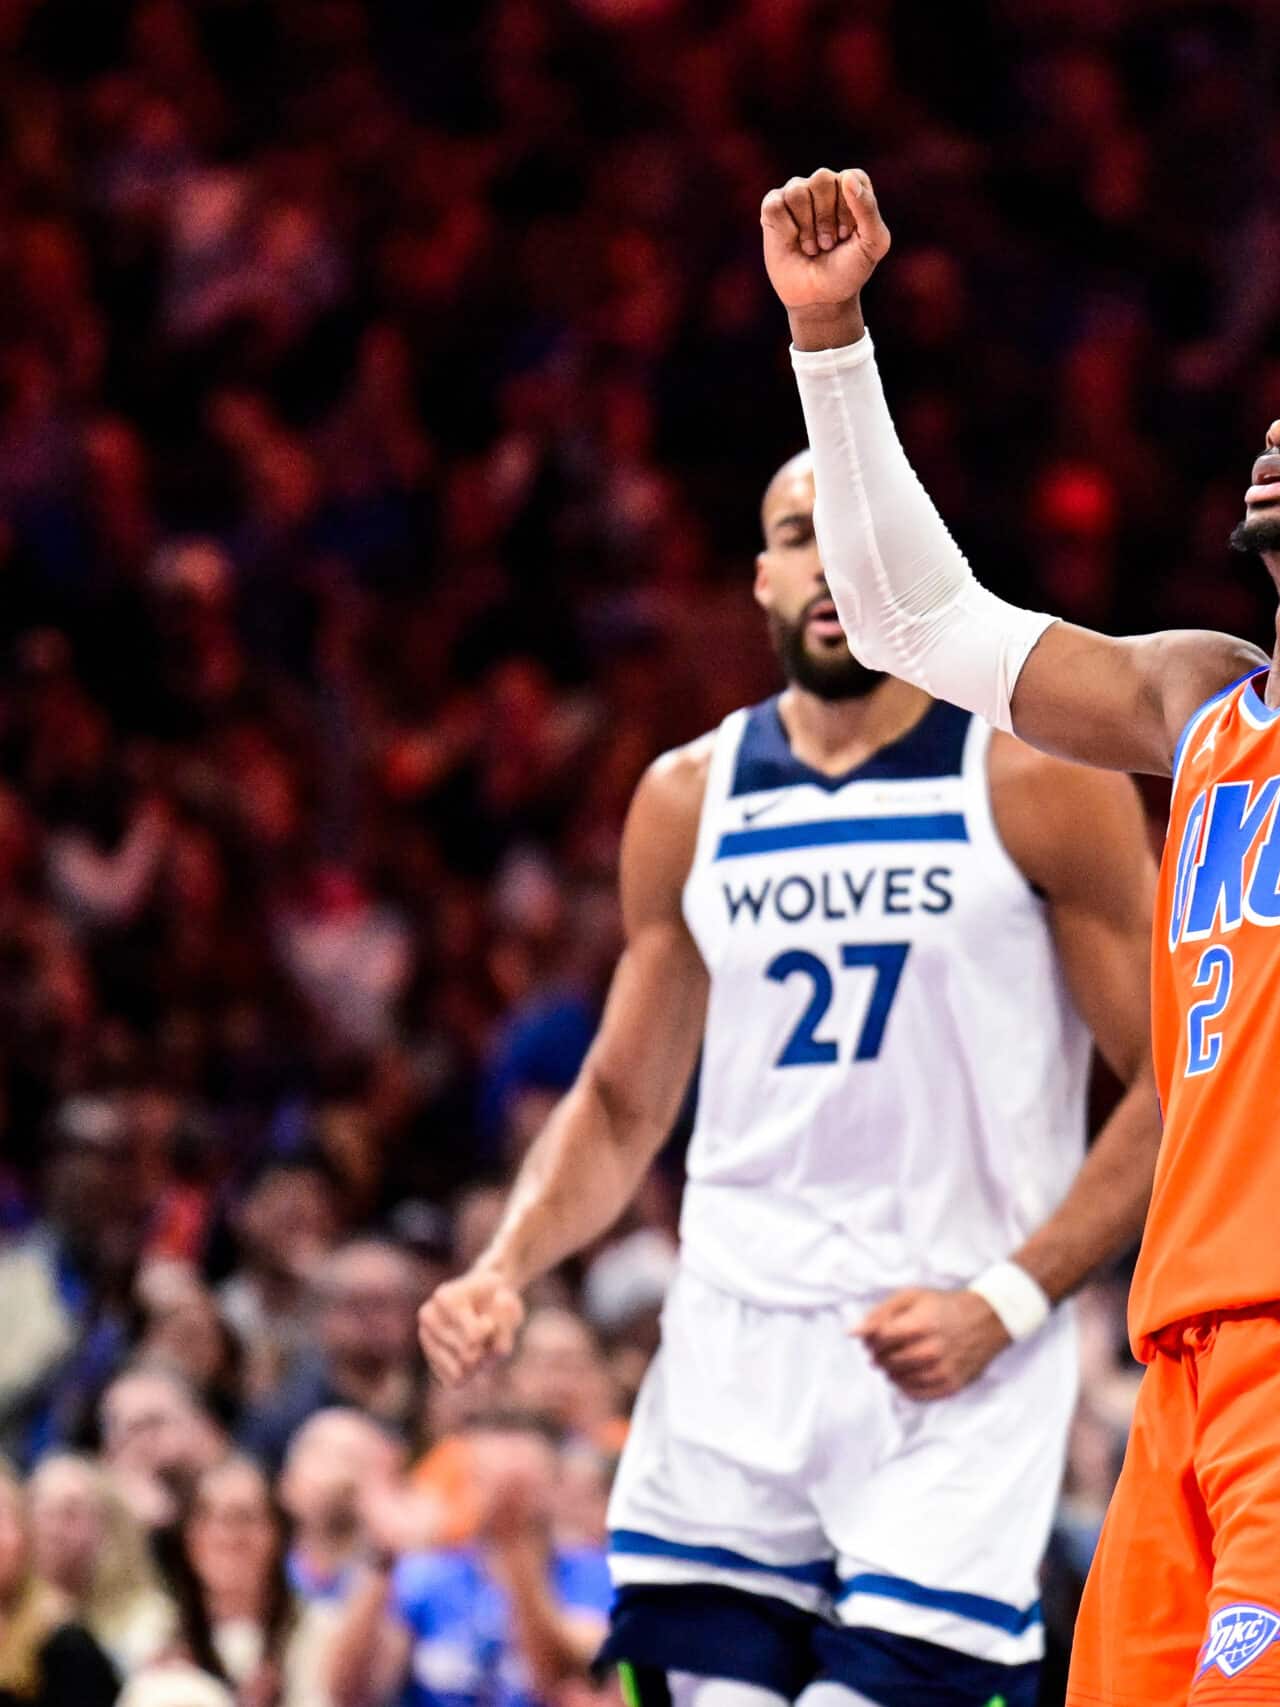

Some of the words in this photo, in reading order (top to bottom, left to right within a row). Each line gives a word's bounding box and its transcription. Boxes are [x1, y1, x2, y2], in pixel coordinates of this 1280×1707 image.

[722, 866, 954, 926] WOLVES
[763, 942, 911, 1069] 27
[1183, 943, 1233, 1078] 2
[1203, 1619, 1264, 1664] OKC
